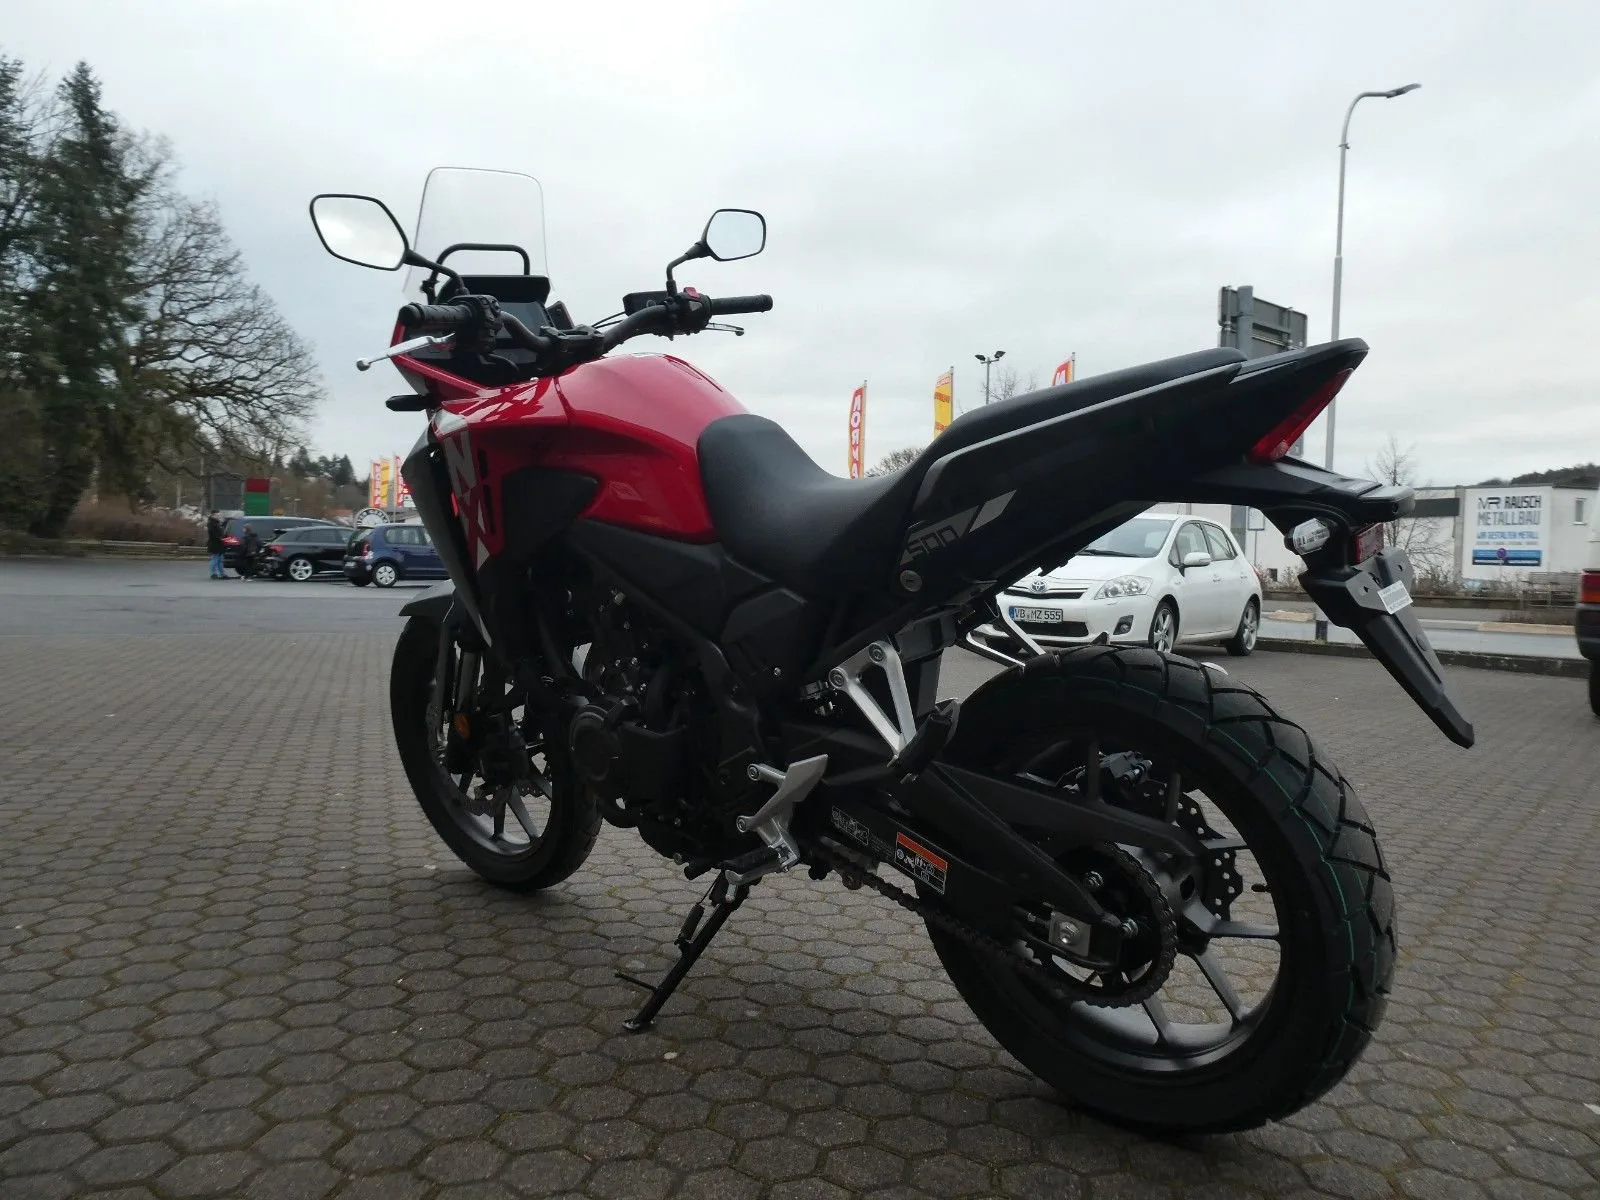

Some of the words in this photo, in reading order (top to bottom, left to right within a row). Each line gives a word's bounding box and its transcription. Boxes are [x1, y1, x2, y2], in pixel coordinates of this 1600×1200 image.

[1504, 496, 1541, 509] RAUSCH
[1478, 511, 1540, 525] METALLBAU
[907, 524, 959, 556] 500
[1015, 608, 1026, 618] VB
[1031, 610, 1042, 619] MZ
[1044, 611, 1061, 620] 555
